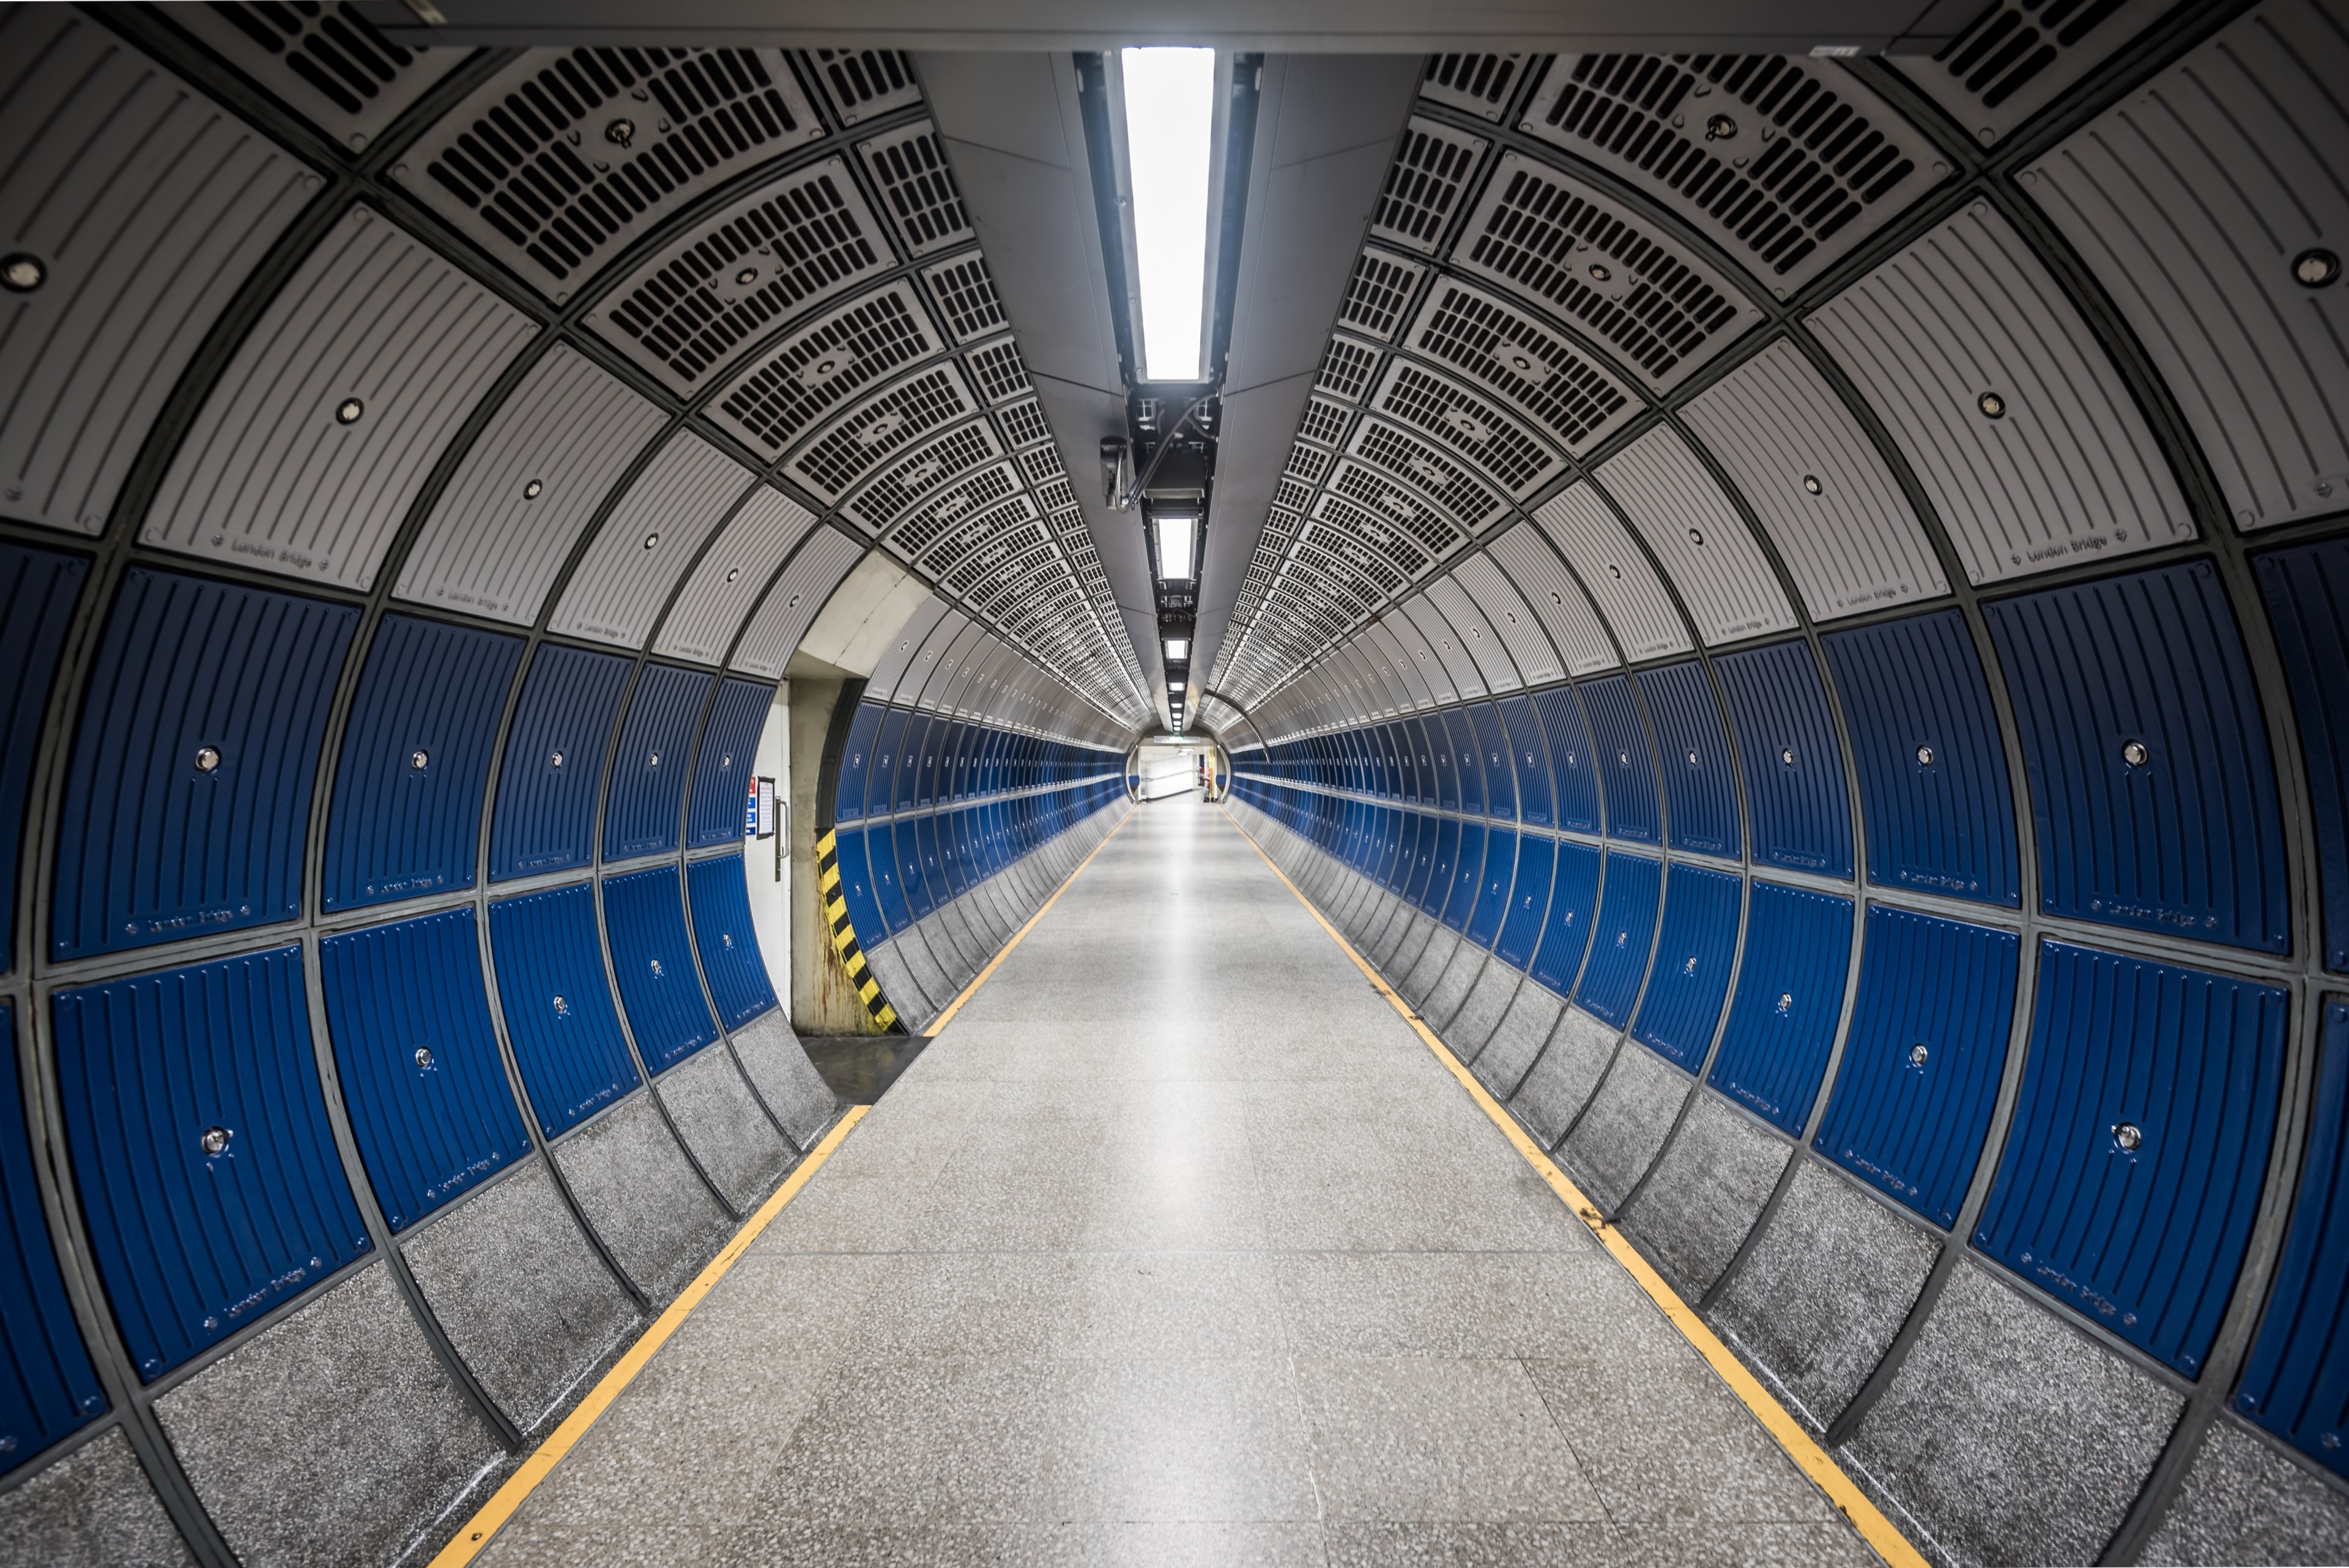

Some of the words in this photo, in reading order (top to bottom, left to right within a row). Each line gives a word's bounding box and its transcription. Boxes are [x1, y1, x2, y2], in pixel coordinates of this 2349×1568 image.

[231, 535, 276, 560] London
[278, 549, 313, 569] Bridge
[2026, 544, 2068, 563] London
[2069, 535, 2107, 553] Bridge
[1846, 593, 1872, 607] London
[1873, 587, 1897, 600] Bridge
[147, 915, 195, 932] London
[198, 909, 234, 923] Bridge
[2109, 901, 2153, 919] London
[2156, 908, 2197, 927] Bridge
[223, 1288, 269, 1320] London
[270, 1267, 306, 1292] Bridge
[2036, 1260, 2078, 1292] London
[2080, 1284, 2117, 1316] Bridge
